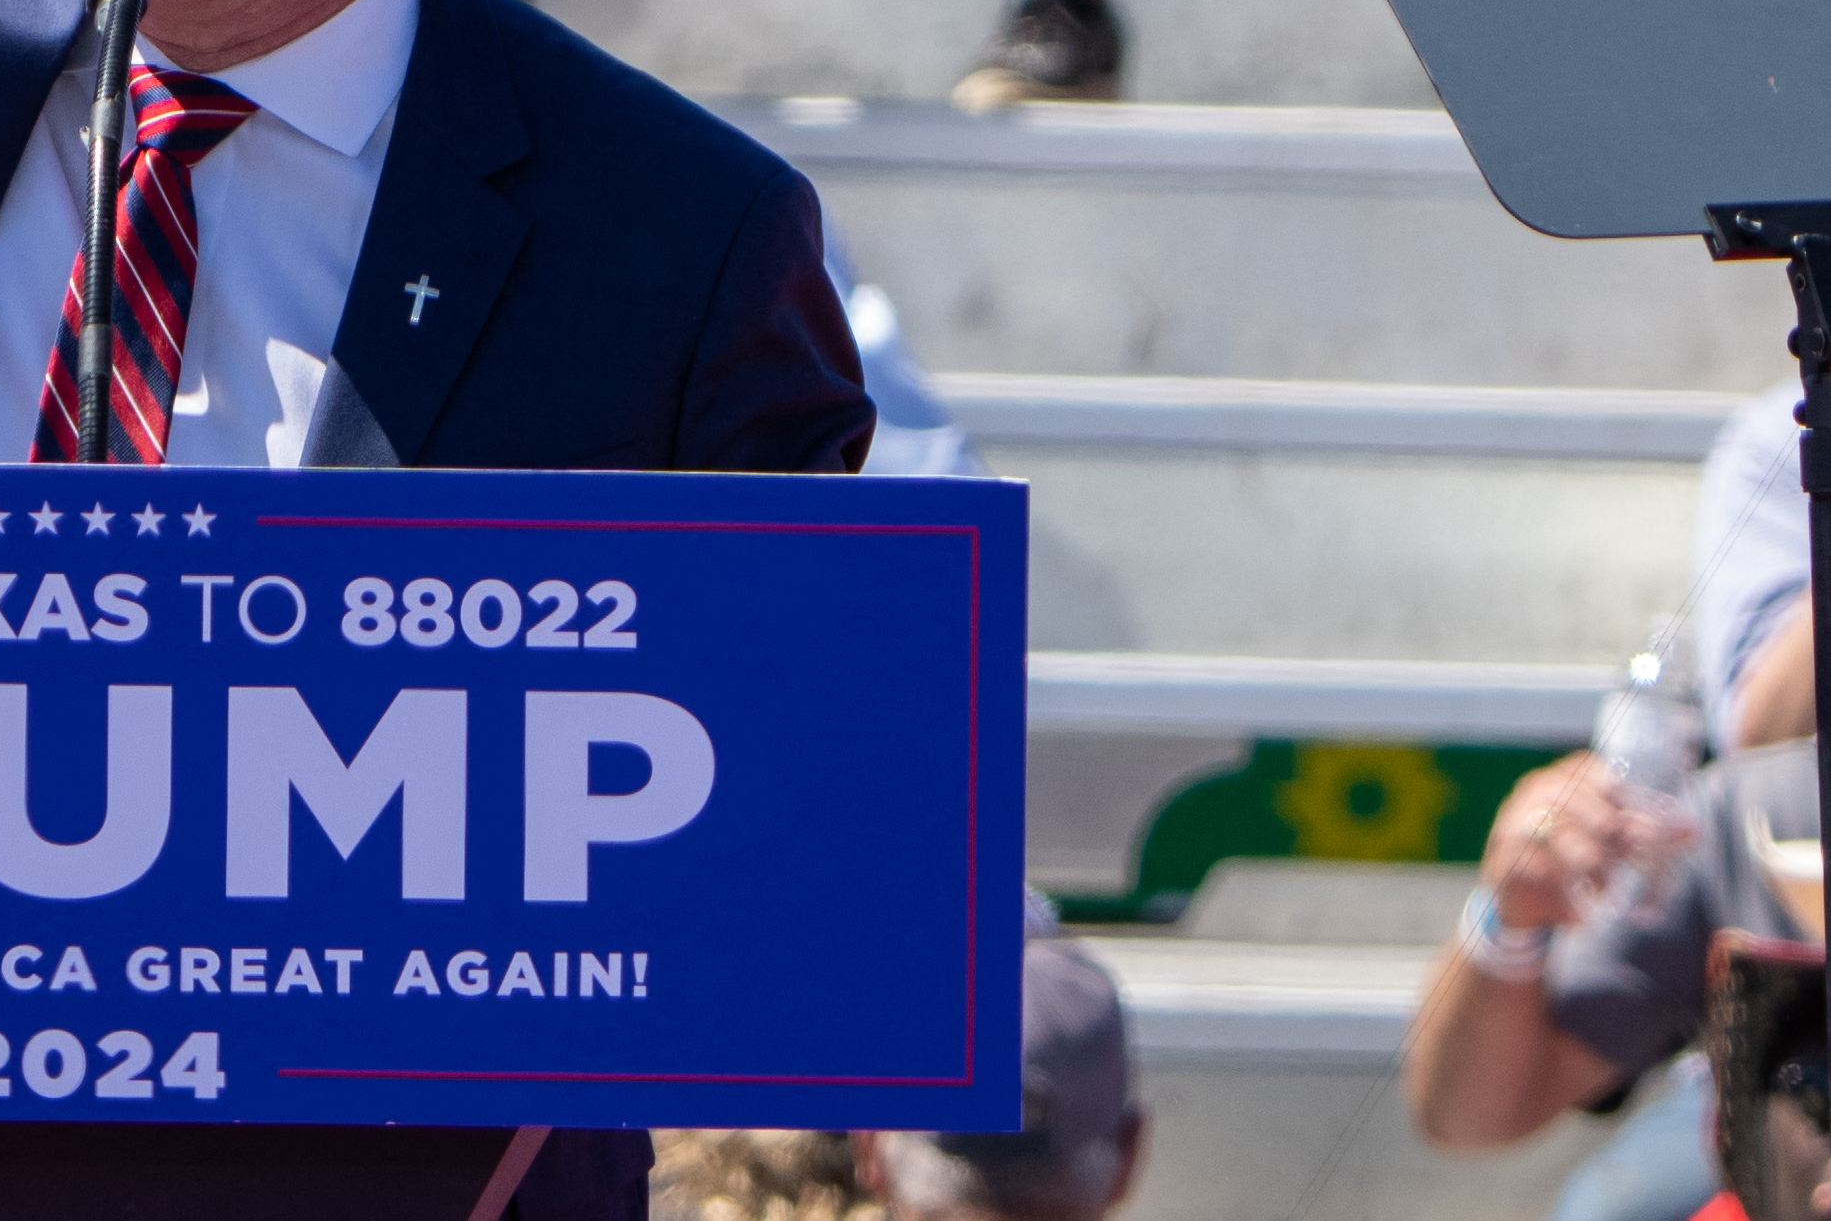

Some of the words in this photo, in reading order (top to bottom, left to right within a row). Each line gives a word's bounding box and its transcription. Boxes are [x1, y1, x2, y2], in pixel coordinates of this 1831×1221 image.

[180, 574, 307, 645] TO
[341, 577, 638, 649] 88022
[126, 946, 365, 995] GREAT
[392, 950, 649, 998] AGAIN!
